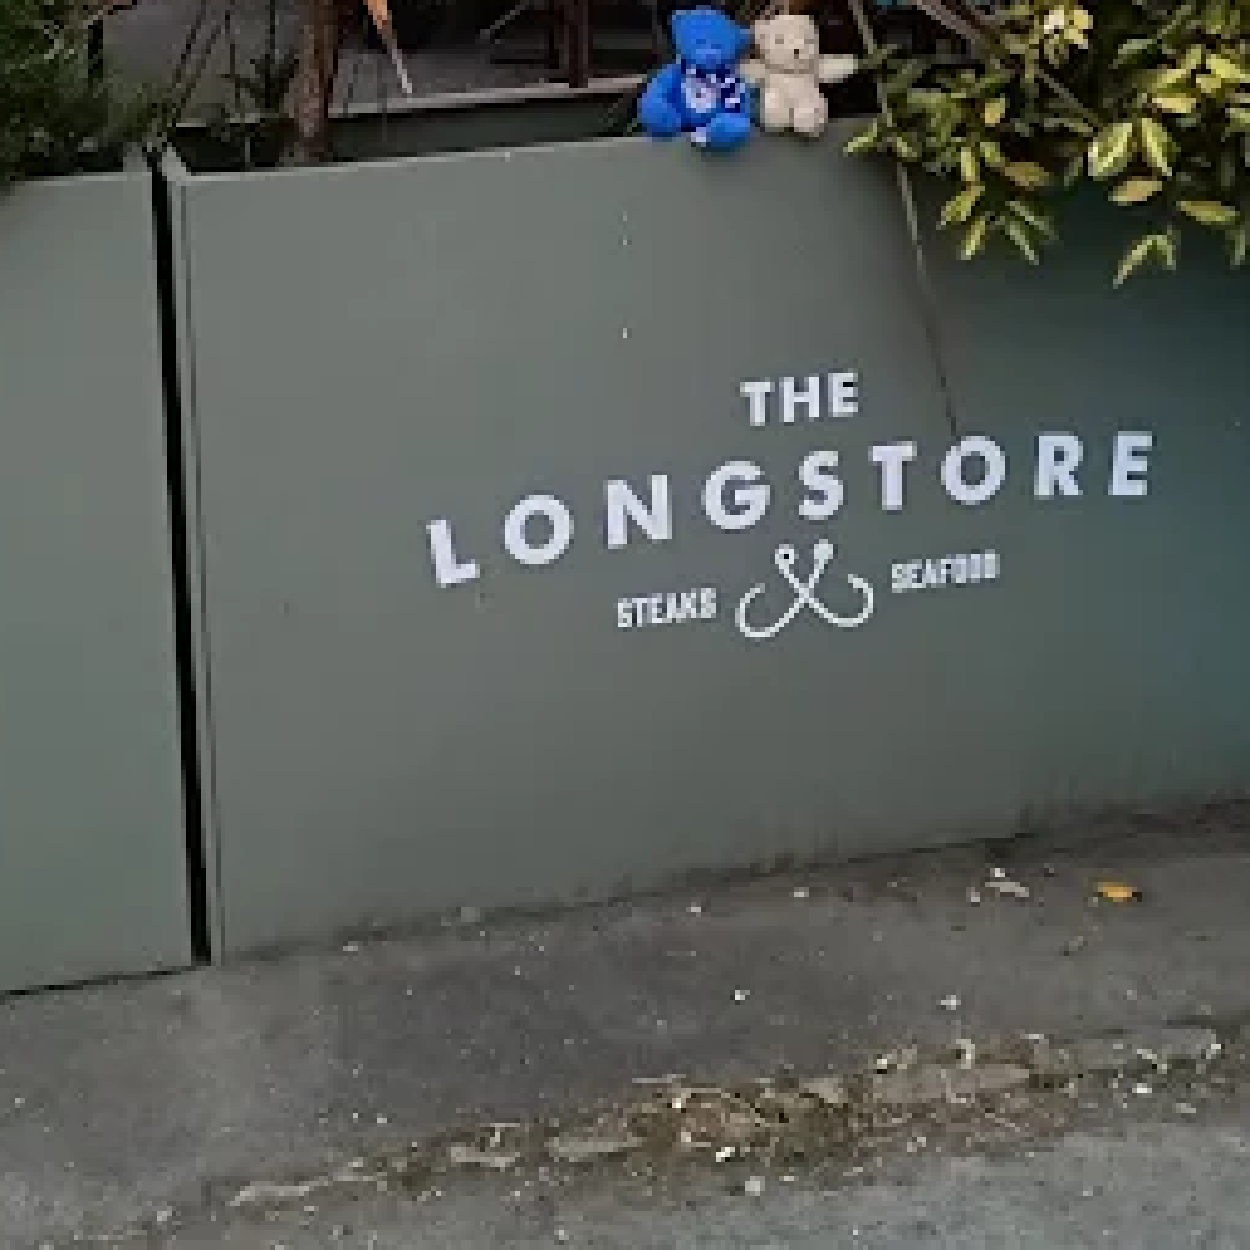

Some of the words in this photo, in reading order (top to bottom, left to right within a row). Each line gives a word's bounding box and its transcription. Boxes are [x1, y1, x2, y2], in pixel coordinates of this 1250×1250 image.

[740, 372, 858, 426] THE
[426, 430, 1153, 587] LONGSTORE
[616, 587, 717, 628] STEAKS
